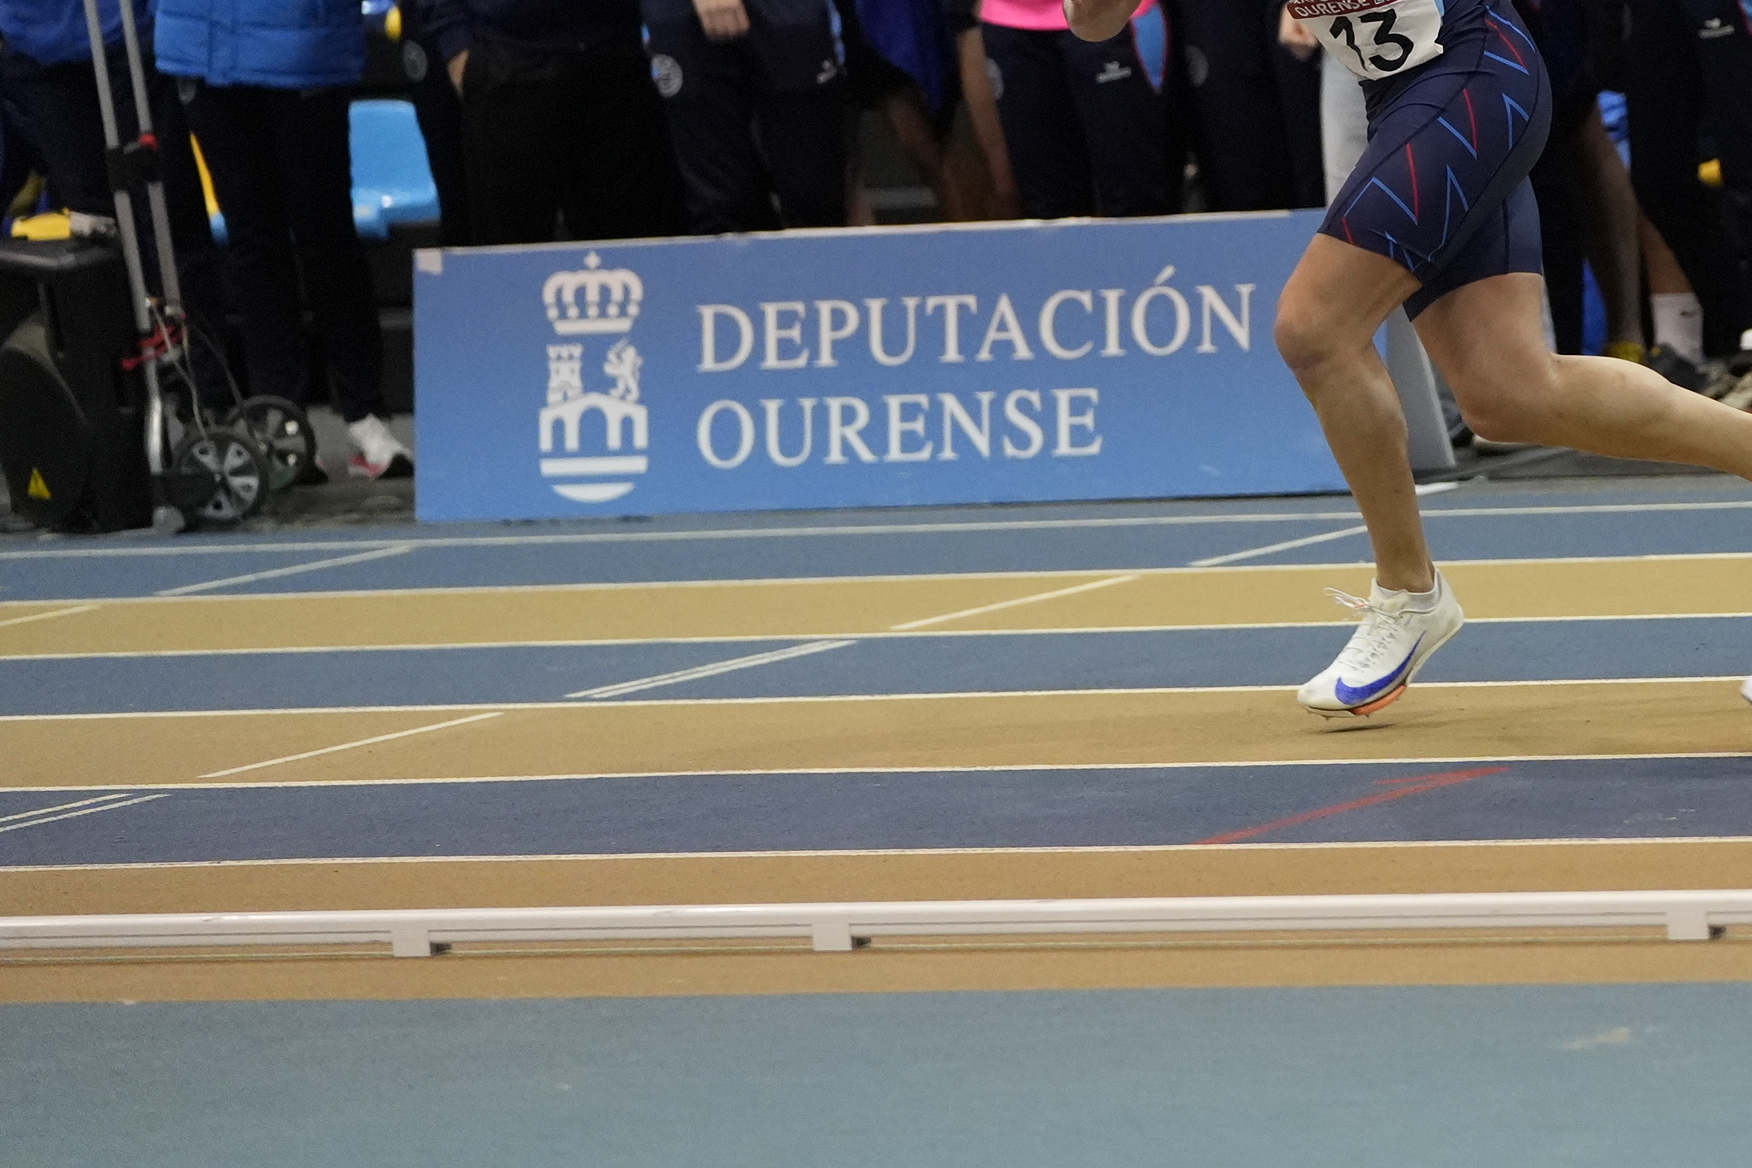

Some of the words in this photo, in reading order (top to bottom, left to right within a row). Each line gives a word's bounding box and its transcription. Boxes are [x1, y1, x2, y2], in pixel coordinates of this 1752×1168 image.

[1329, 8, 1415, 72] 13
[696, 264, 1256, 373] DEPUTACIÓN
[696, 387, 1103, 470] OURENSE
